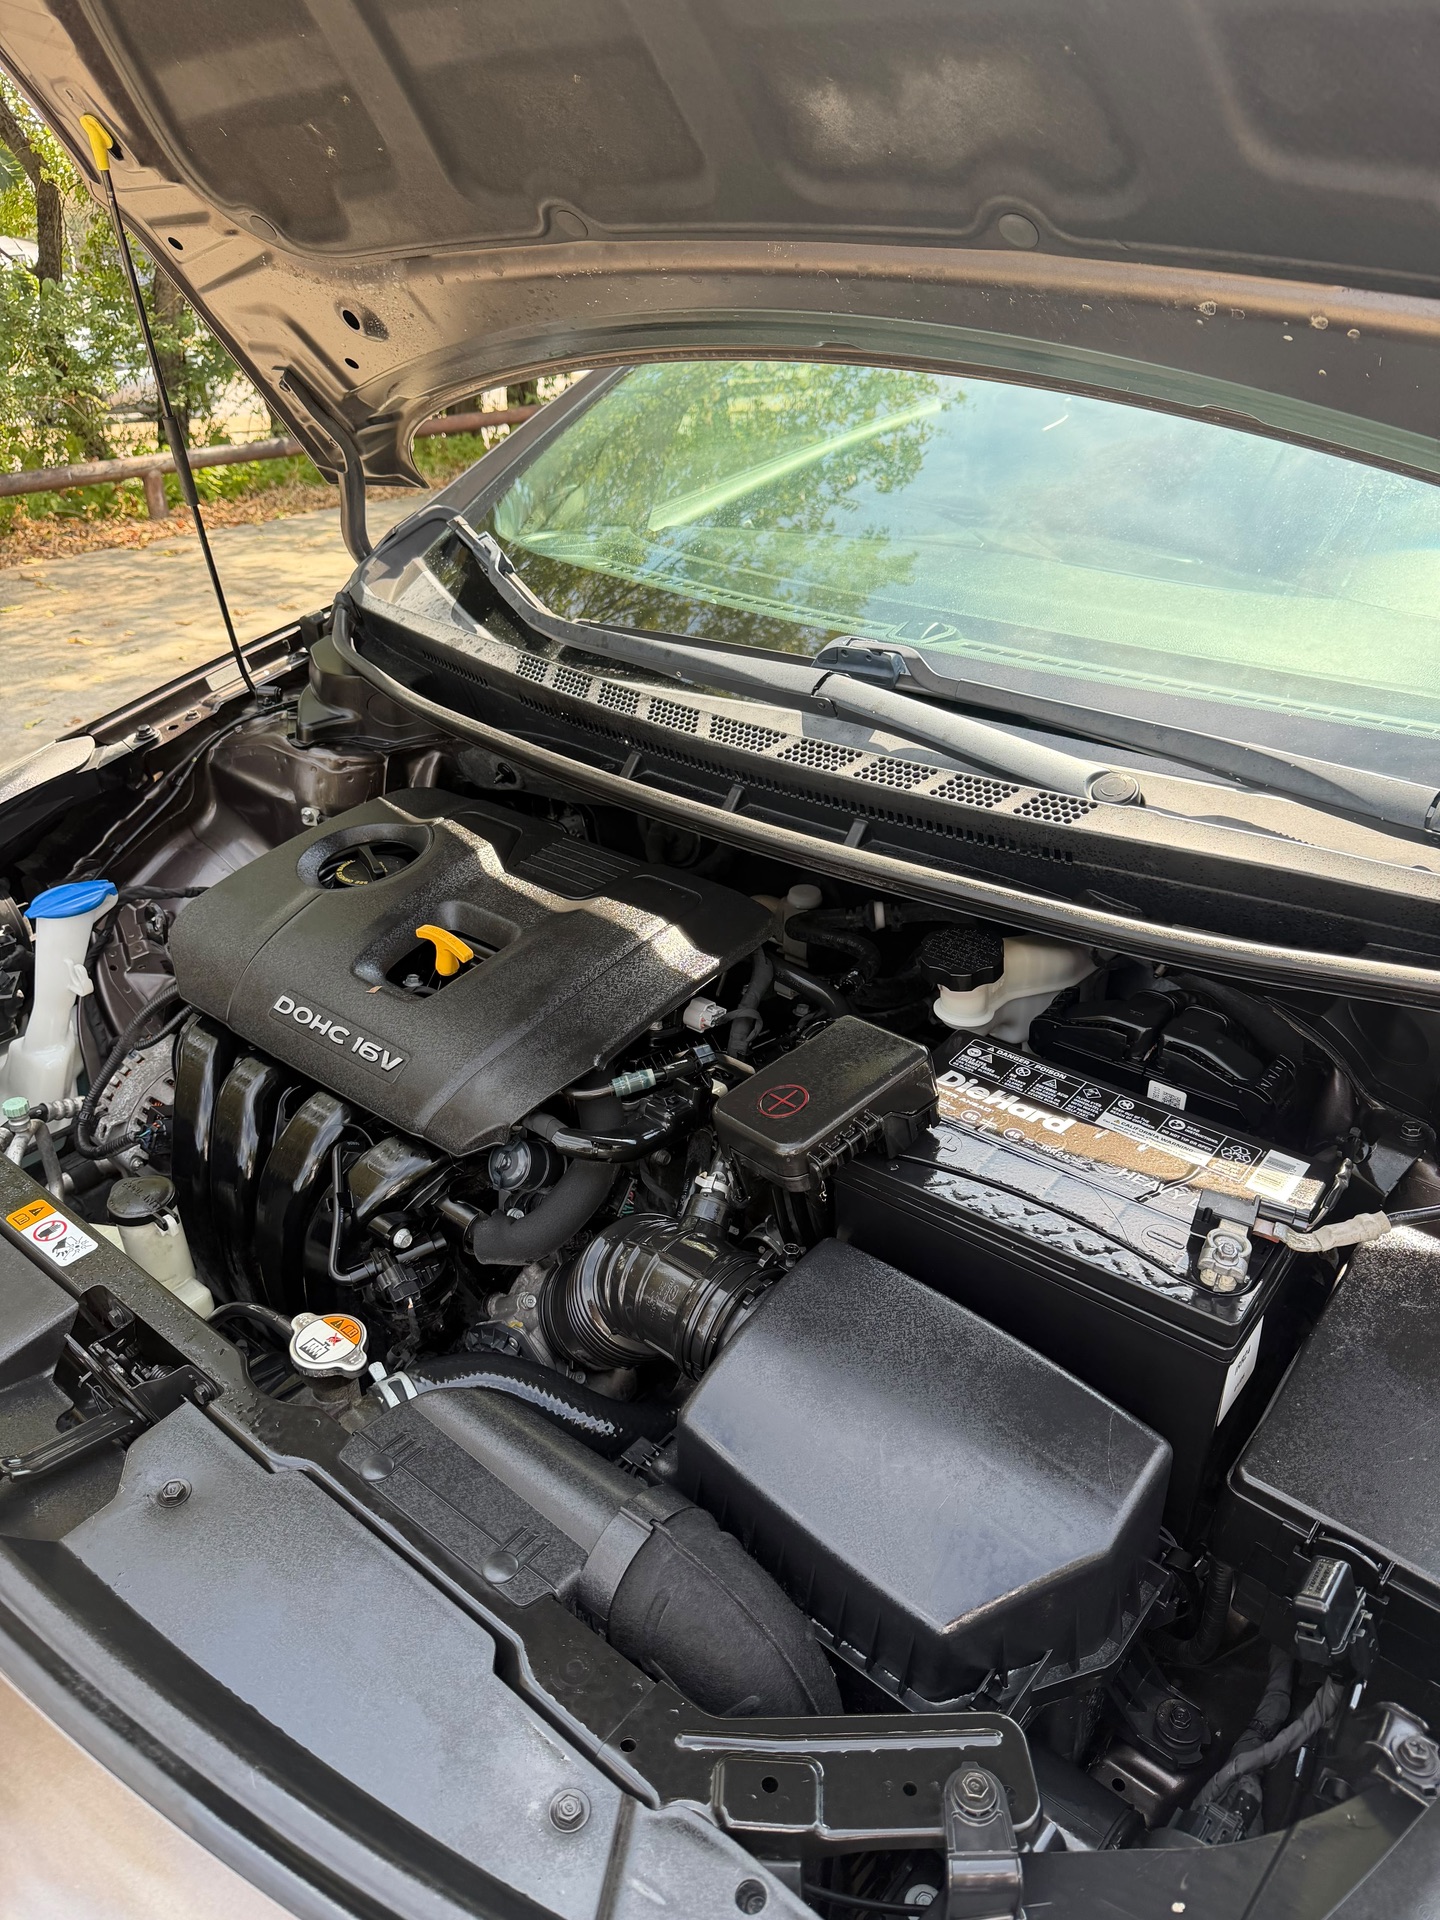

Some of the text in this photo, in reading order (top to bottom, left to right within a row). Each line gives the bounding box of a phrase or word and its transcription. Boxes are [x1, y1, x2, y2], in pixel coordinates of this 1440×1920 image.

[273, 994, 403, 1072] DOHC 16V
[995, 1049, 1030, 1065] DANGER
[1033, 1064, 1067, 1079] POISON
[936, 1070, 1077, 1134] DieHard
[1120, 1121, 1160, 1139] CALIFORNIA
[1197, 1143, 1213, 1151] OPEN
